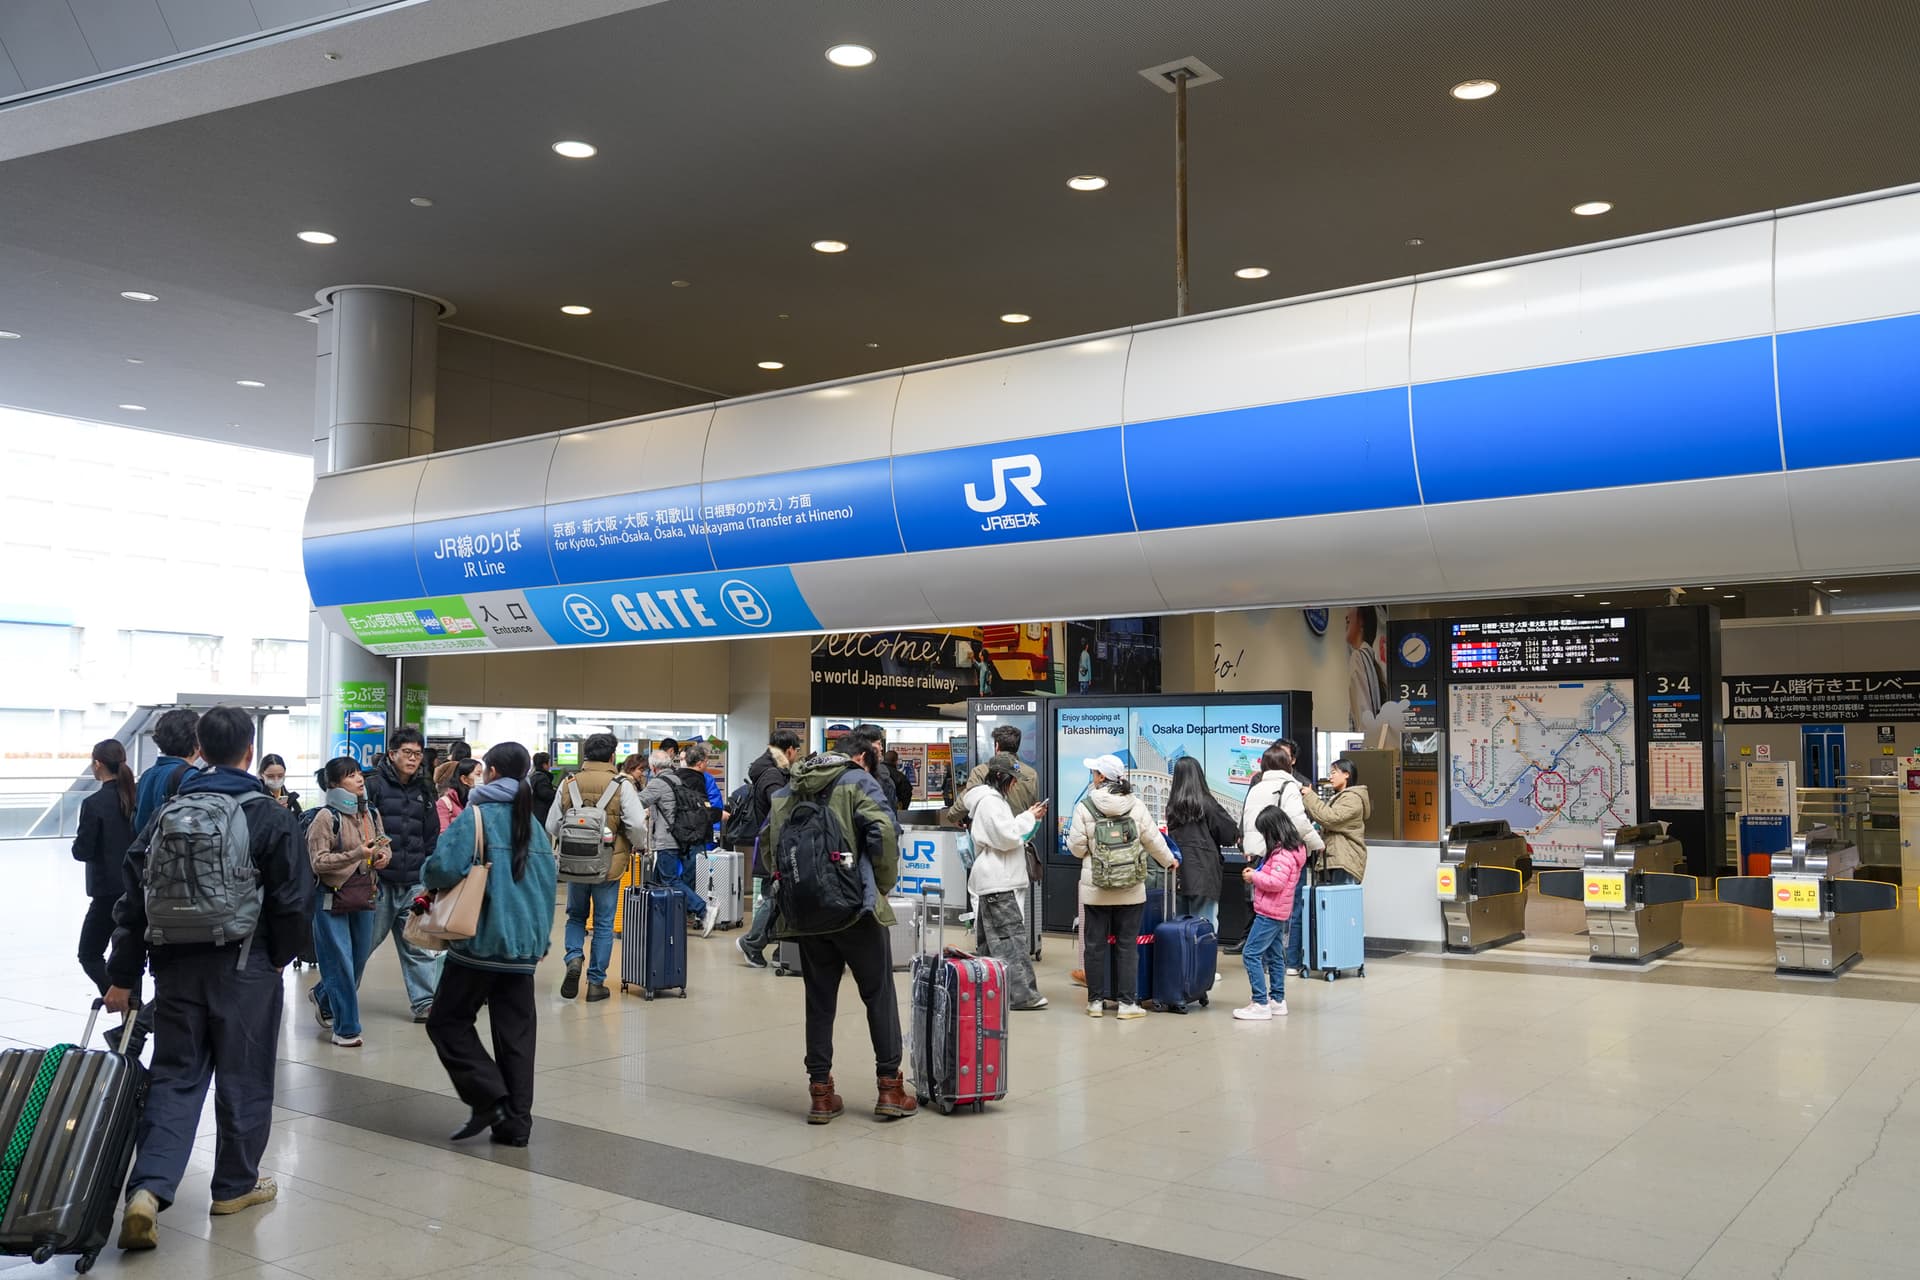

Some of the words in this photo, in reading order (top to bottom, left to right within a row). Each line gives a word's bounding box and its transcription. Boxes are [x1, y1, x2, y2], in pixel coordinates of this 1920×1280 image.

[964, 453, 1047, 513] JR
[554, 539, 568, 551] for
[569, 537, 598, 552] Kyōto,
[599, 530, 653, 545] Shin-Ōsaka,
[654, 525, 686, 540] Ōsaka,
[688, 520, 744, 536] Wakayama
[746, 512, 793, 530] (Transfer
[795, 511, 806, 524] at
[808, 504, 853, 523] Hineno)
[981, 512, 1040, 531] JR西日本
[434, 528, 522, 559] JR線のりば
[464, 562, 478, 578] JR
[478, 560, 506, 577] Line
[479, 602, 527, 622] 入口
[611, 588, 717, 631] GATE
[492, 625, 533, 635] Entrance
[825, 669, 858, 684] world
[862, 670, 914, 689] Japanese
[917, 674, 958, 693] railway.
[984, 703, 1025, 712] Information
[1062, 714, 1080, 722] Enjoy
[1081, 714, 1112, 722] shopping
[1062, 725, 1124, 736] Takashimaya
[1152, 723, 1183, 734] Osaka
[1187, 723, 1248, 736] Department
[1251, 723, 1280, 733] Store
[902, 840, 935, 862] JR
[1794, 889, 1816, 897] 出口
